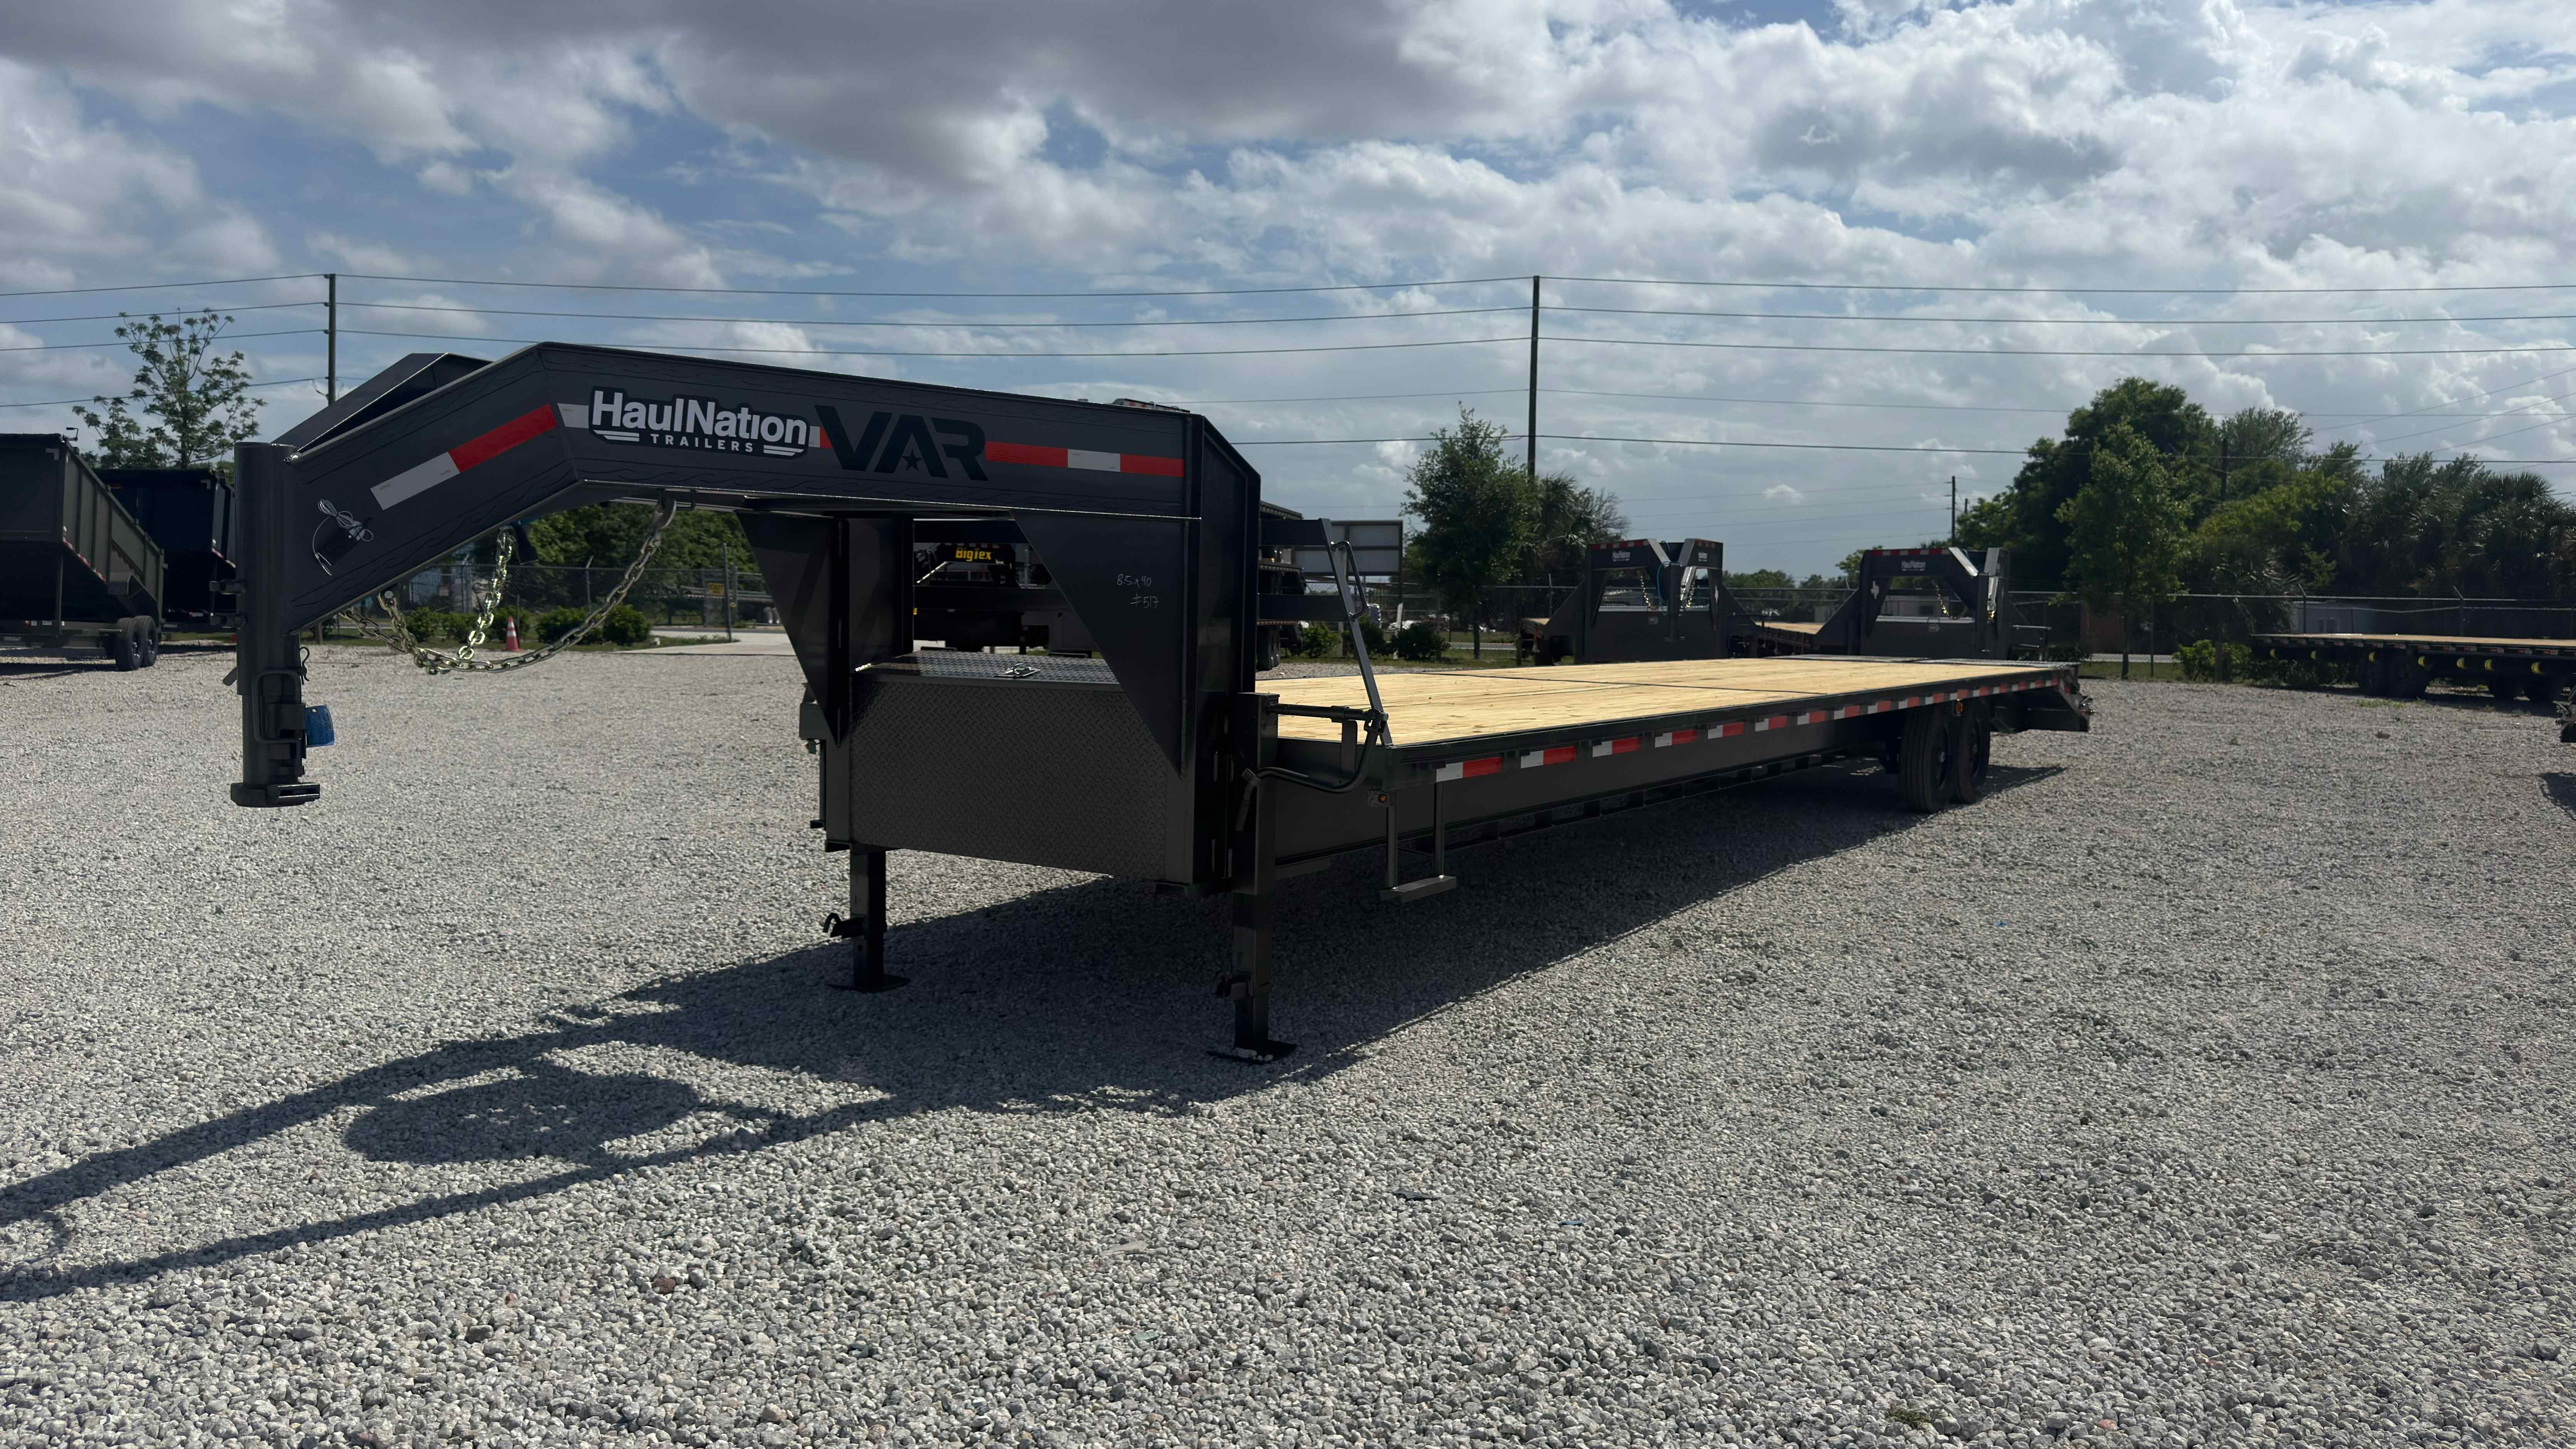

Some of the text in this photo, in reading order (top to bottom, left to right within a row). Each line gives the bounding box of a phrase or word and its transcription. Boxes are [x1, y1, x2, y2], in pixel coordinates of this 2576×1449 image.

[592, 390, 807, 445] HaulNation
[651, 434, 753, 453] TRAILERS
[814, 405, 989, 481] VAR
